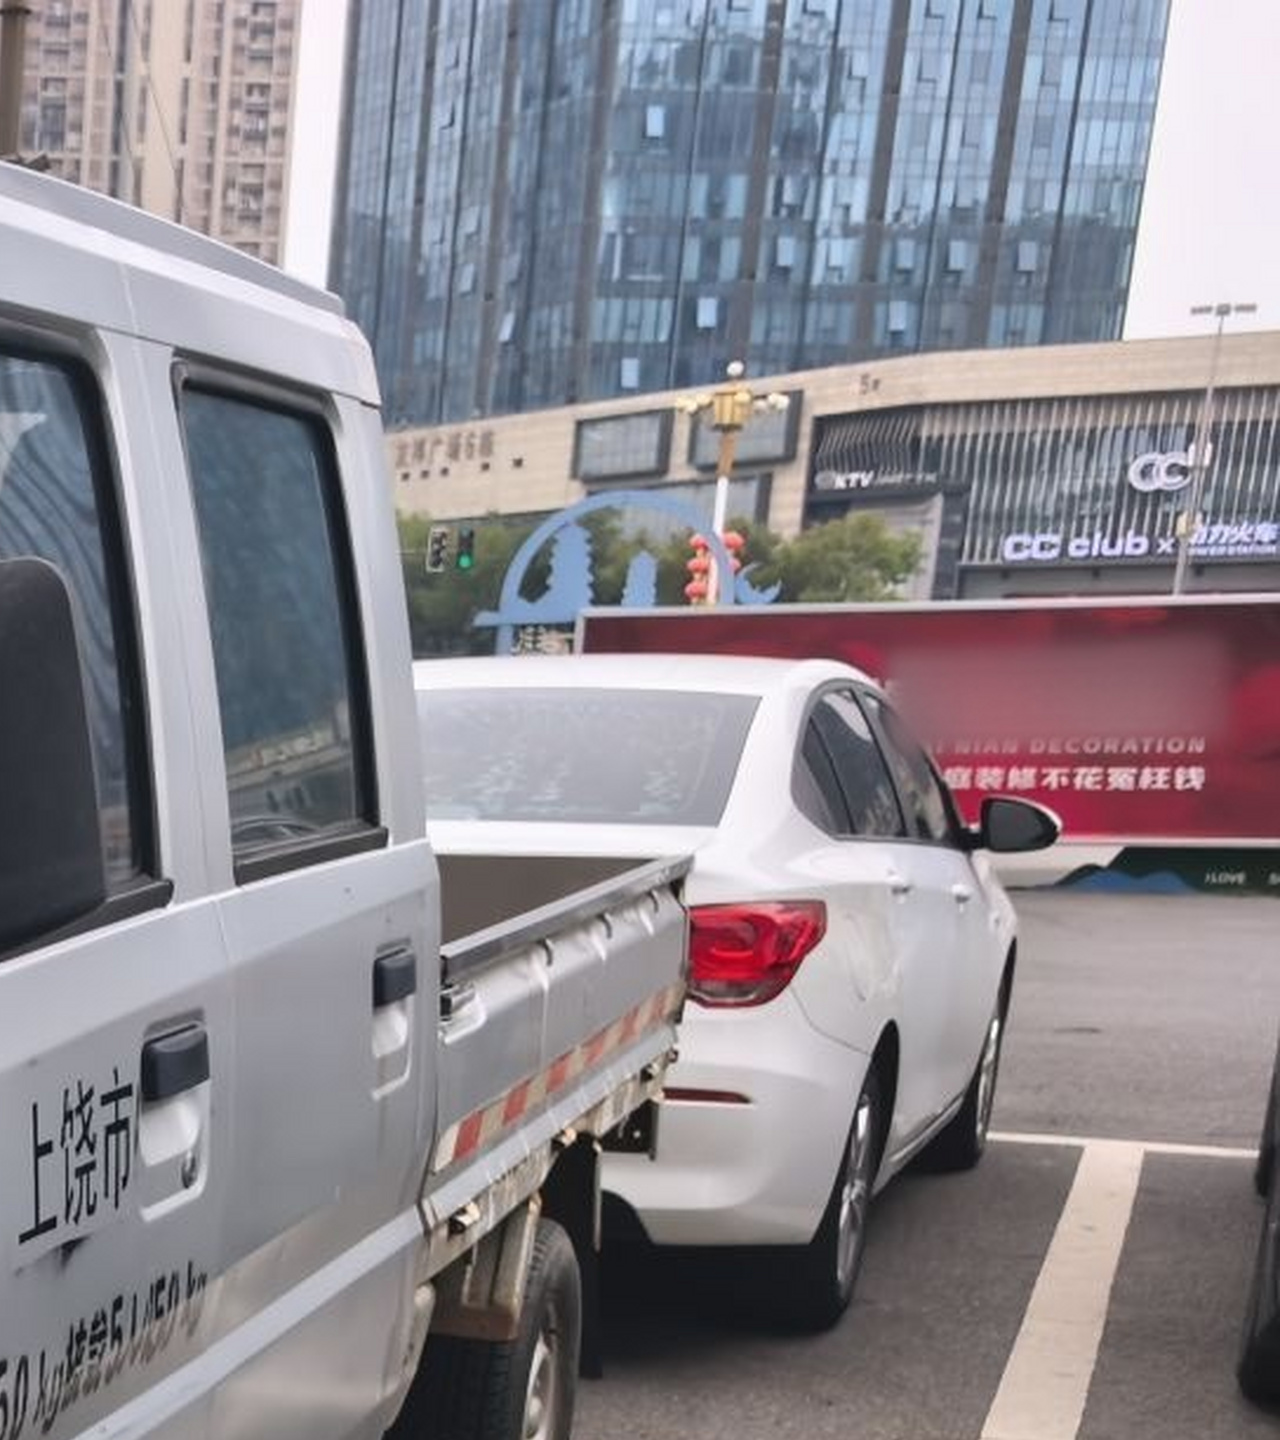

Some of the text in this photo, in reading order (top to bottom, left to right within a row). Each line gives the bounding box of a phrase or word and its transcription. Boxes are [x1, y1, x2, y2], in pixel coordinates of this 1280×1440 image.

[1004, 533, 1060, 560] CC
[1068, 530, 1150, 557] club
[1030, 736, 1206, 754] DECORATION
[18, 1066, 134, 1245] 上饶市
